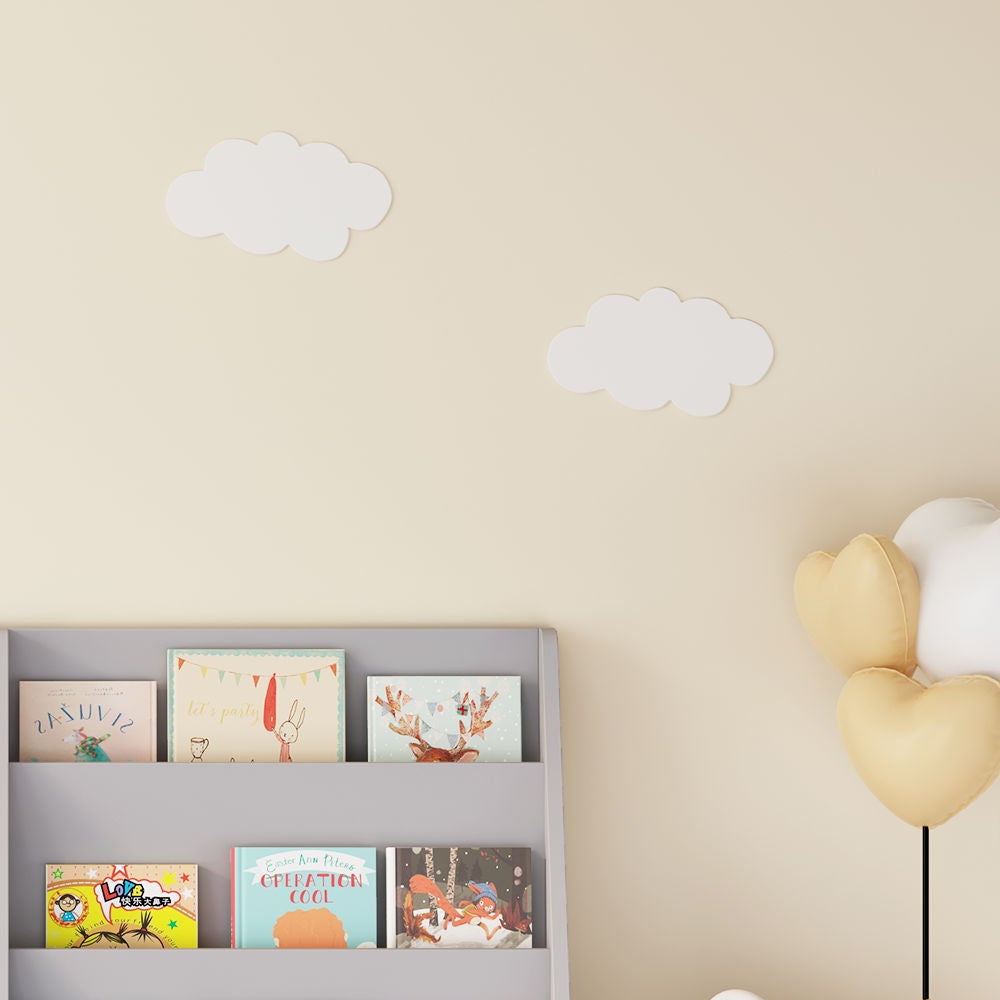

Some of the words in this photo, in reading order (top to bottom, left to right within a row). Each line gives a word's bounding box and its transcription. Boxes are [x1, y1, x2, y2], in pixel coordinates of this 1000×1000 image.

[219, 701, 260, 727] party
[260, 873, 363, 888] OPERATION
[289, 889, 334, 904] COOL
